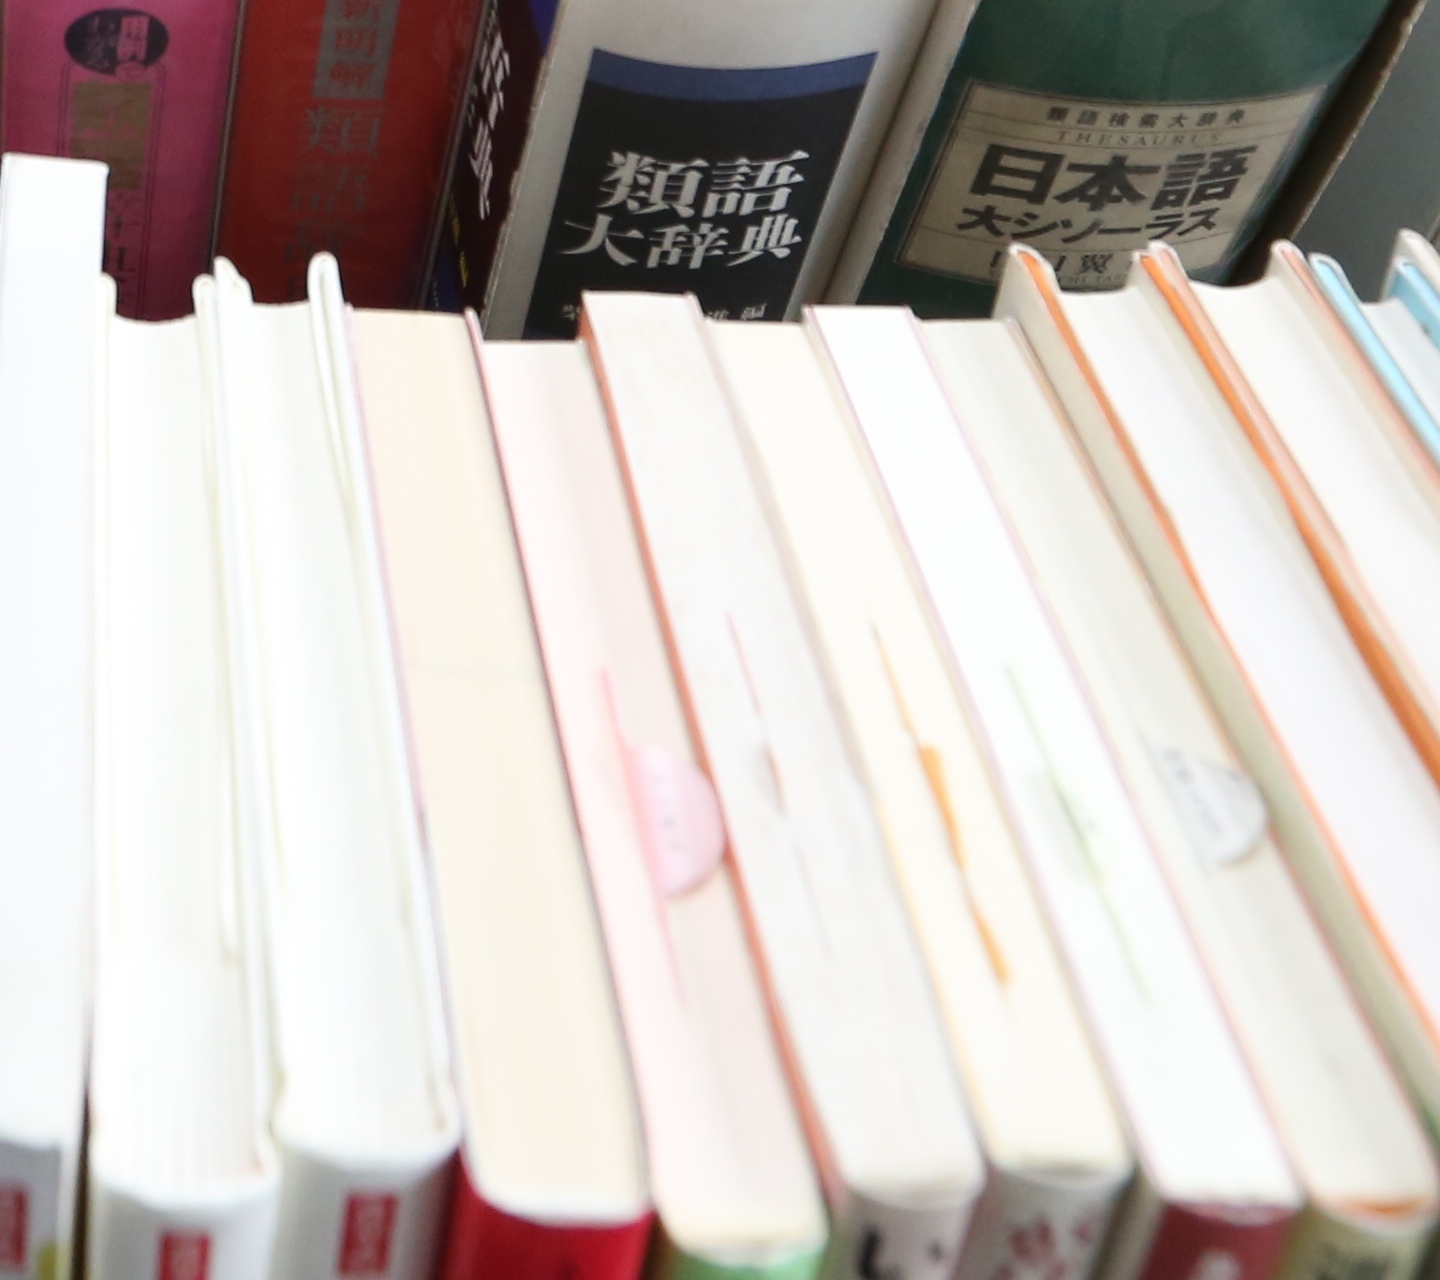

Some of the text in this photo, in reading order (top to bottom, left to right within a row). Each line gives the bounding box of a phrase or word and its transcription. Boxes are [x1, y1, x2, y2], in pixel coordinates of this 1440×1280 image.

[1045, 105, 1247, 127] 類語検索大辞典
[1057, 129, 1221, 147] THESAURUS
[595, 149, 811, 220] 類語
[968, 143, 1260, 213] 日本語
[557, 213, 804, 270] 大辞典
